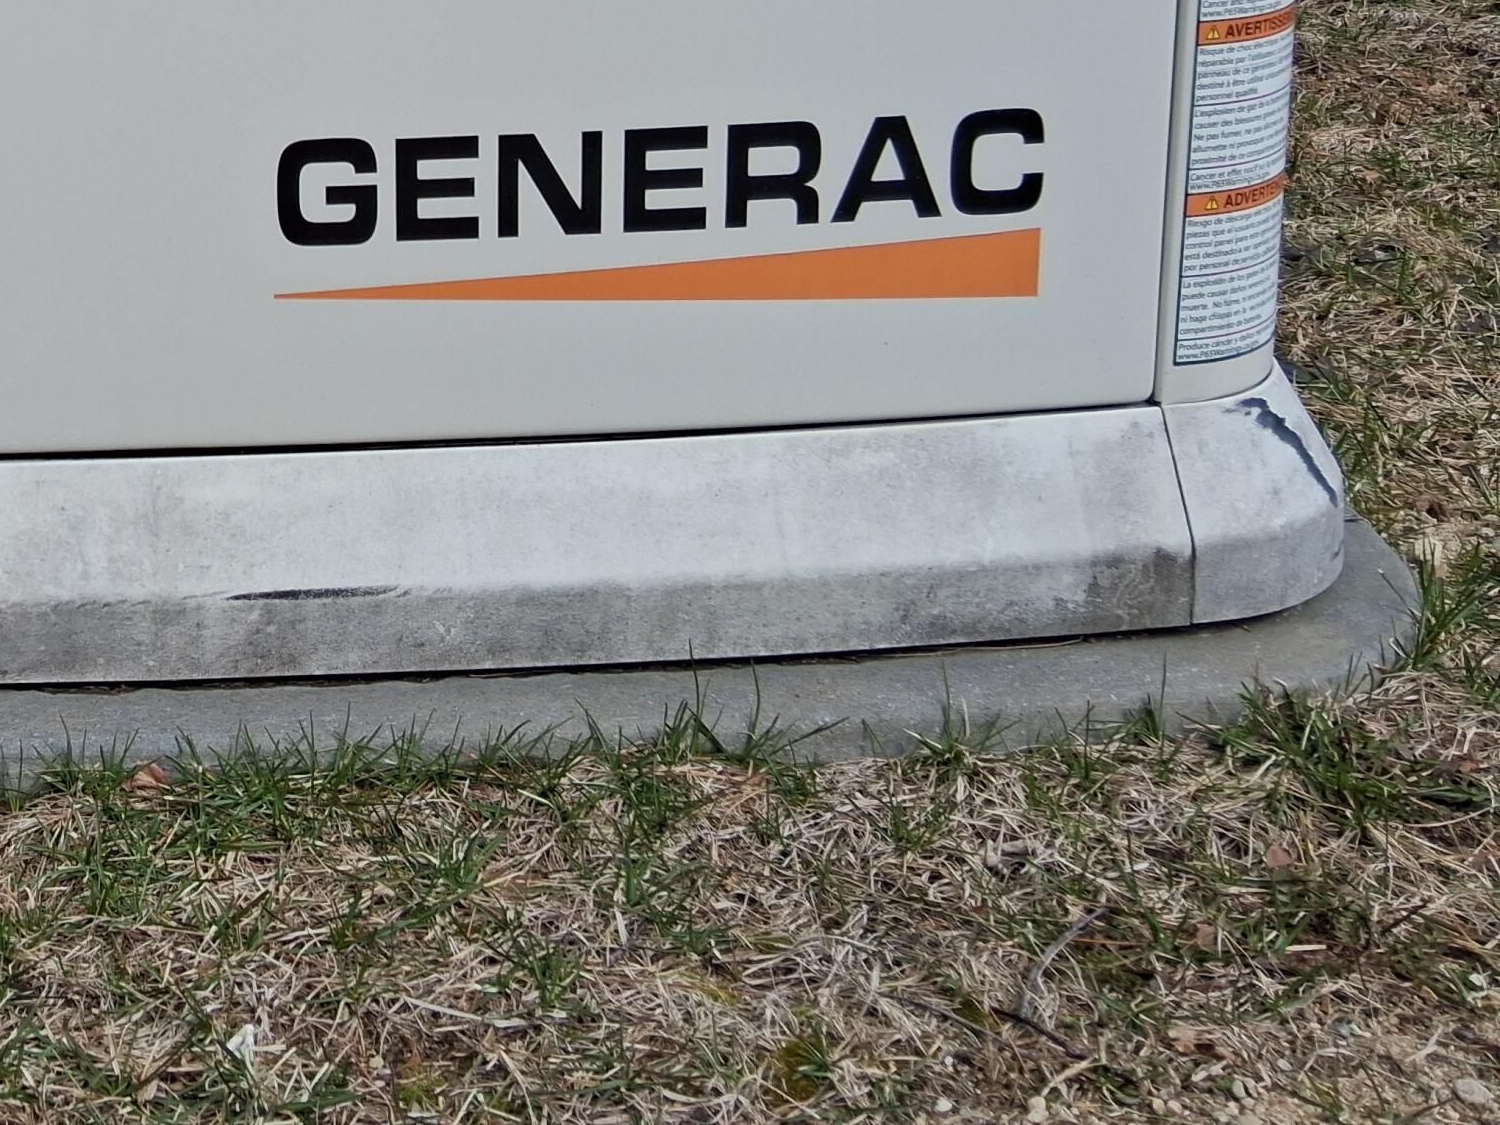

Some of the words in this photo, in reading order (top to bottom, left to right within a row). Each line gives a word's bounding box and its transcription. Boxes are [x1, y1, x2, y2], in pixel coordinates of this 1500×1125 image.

[1203, 0, 1229, 9] Cancer
[1200, 47, 1224, 57] Risque
[1226, 45, 1236, 54] de
[1196, 92, 1234, 103] personnel
[1194, 121, 1220, 130] causer
[1193, 134, 1204, 142] Ne
[1206, 134, 1220, 143] pas
[1228, 154, 1237, 162] de
[277, 107, 1044, 246] GENERAC
[1190, 172, 1217, 182] Cancer
[1188, 218, 1213, 229] Riesgo
[1214, 217, 1224, 225] de
[1211, 228, 1225, 238] que
[1185, 240, 1213, 250] control
[1184, 252, 1201, 261] está
[1184, 264, 1199, 273] por
[1199, 259, 1230, 270] personal
[1182, 281, 1192, 289] La
[1227, 275, 1236, 283] de
[1212, 300, 1223, 309] No
[1180, 315, 1188, 324] ni
[1178, 342, 1210, 351] Produce
